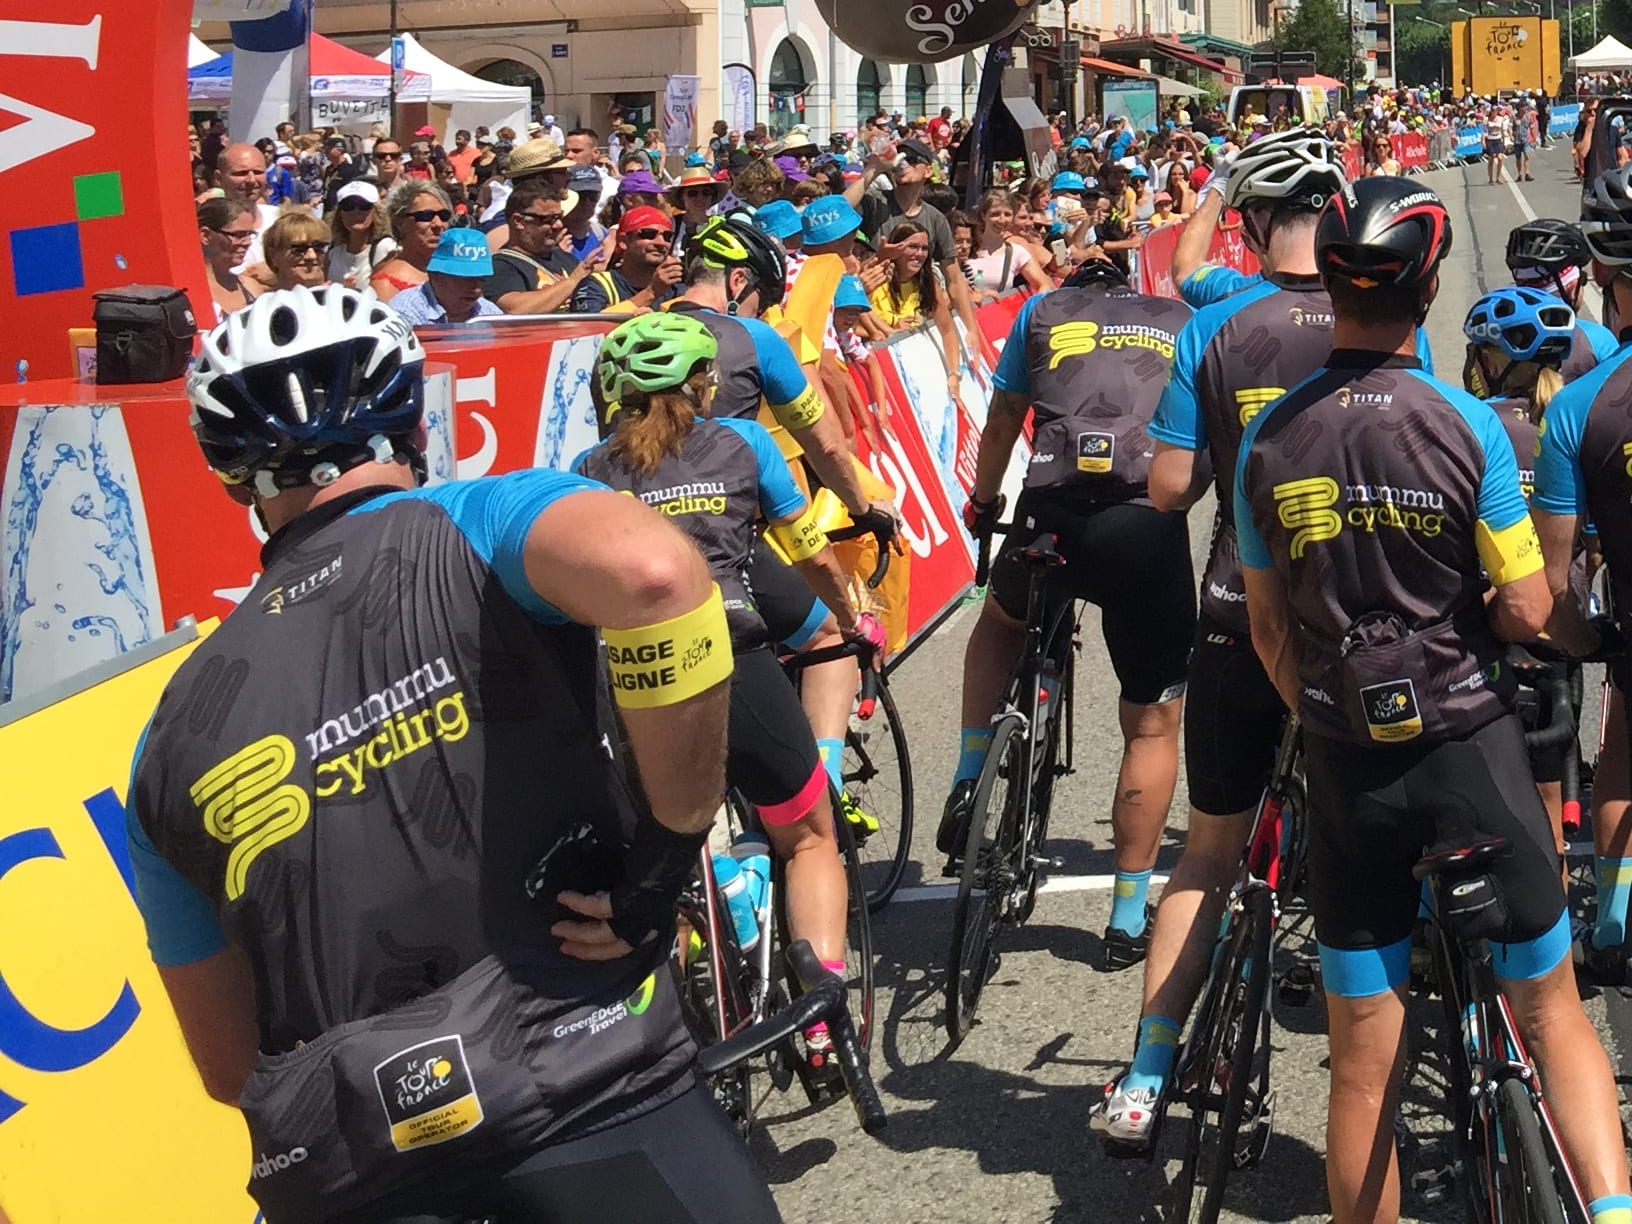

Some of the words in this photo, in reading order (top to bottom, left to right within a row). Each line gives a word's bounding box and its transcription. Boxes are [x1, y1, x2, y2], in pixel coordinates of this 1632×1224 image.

[1388, 191, 1441, 214] S-WORKS
[809, 209, 841, 227] Krys
[453, 243, 488, 261] Krys
[1304, 313, 1335, 324] TITA
[1099, 331, 1175, 360] cycling
[1101, 322, 1176, 344] mummu
[1353, 393, 1393, 405] TITAN
[1345, 482, 1446, 512] mummu
[1346, 503, 1446, 540] cycling
[287, 554, 345, 600] TITAN
[608, 638, 675, 666] SAGE
[303, 655, 457, 761] mummu
[314, 690, 471, 798] cycling
[552, 999, 626, 1039] GreenEDGE
[588, 1006, 629, 1035] Travel
[407, 1107, 460, 1131] OFFICIAL
[408, 1119, 470, 1145] OPERATOR
[250, 1145, 309, 1181] ahoo
